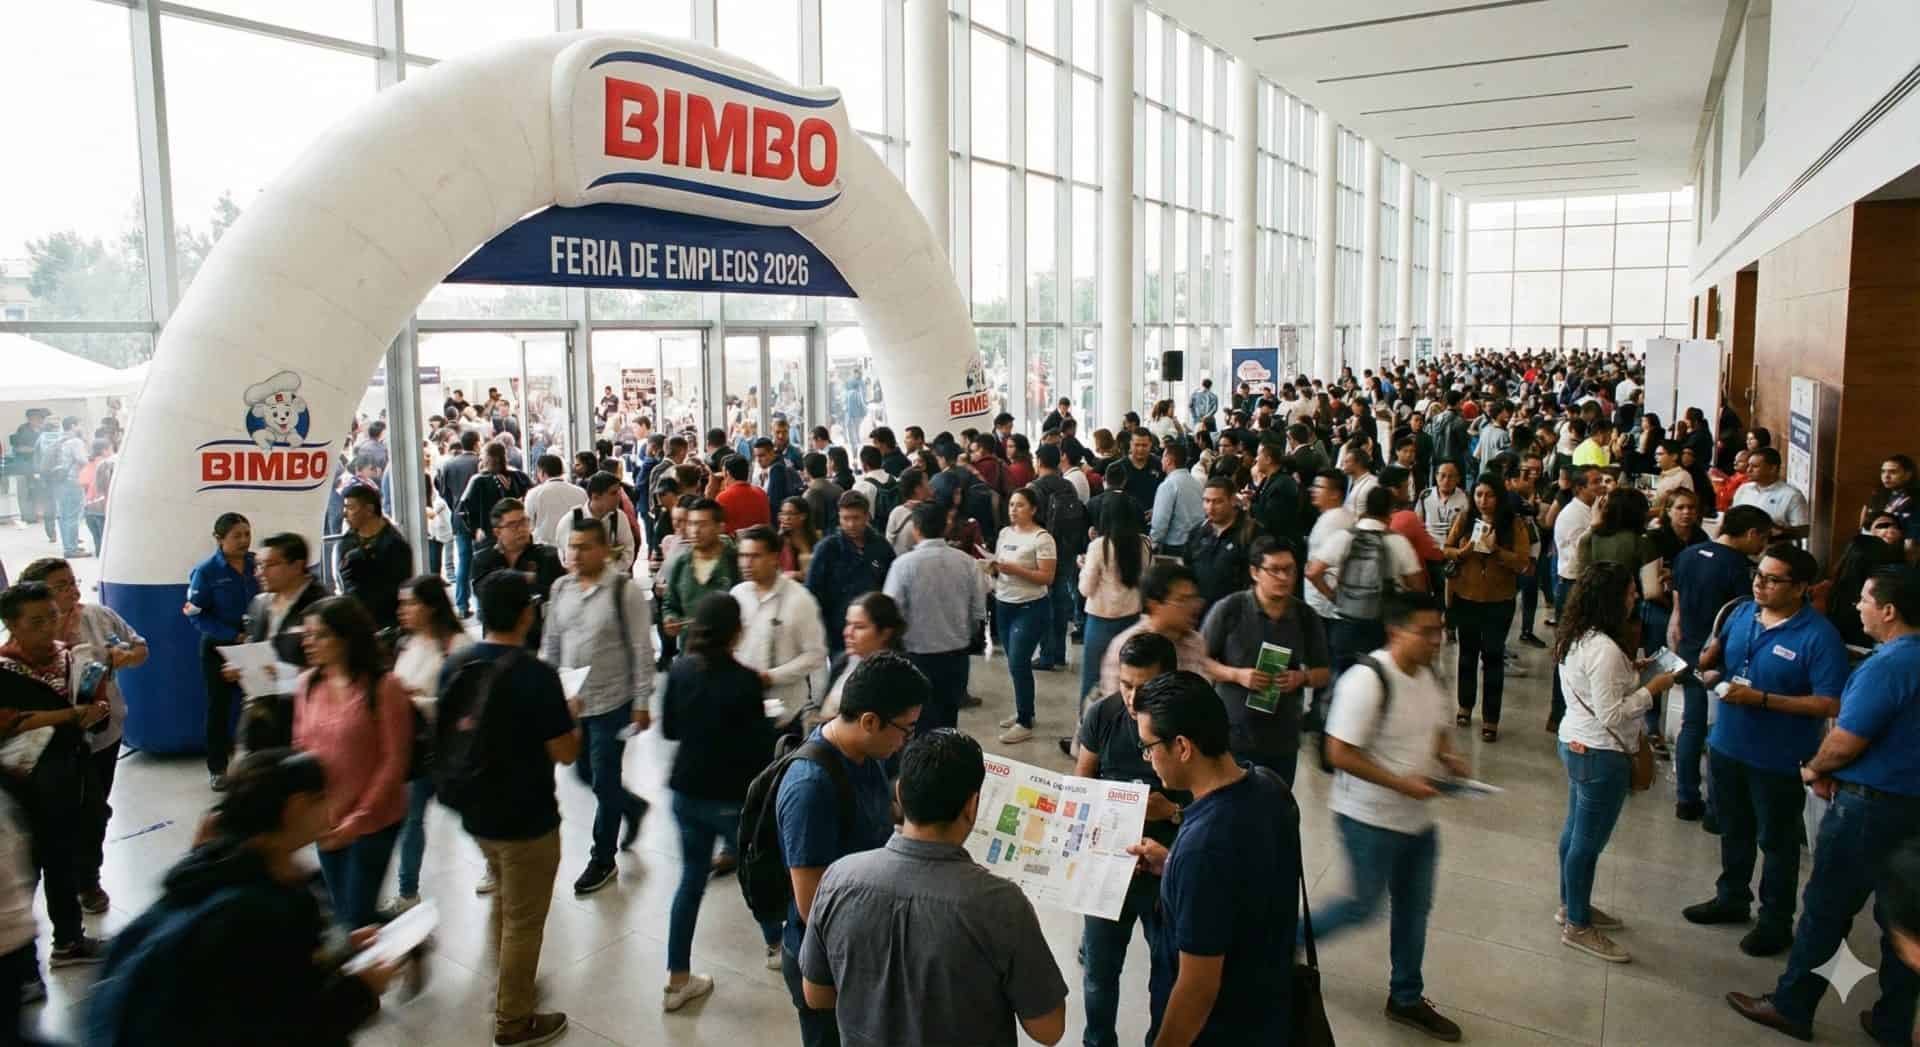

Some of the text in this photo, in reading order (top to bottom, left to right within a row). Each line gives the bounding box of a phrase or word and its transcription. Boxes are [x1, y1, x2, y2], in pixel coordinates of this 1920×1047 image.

[604, 76, 838, 187] BIMBO
[551, 235, 809, 286] FERIA DE EMPLEOS 2026
[950, 393, 989, 416] BIMB
[202, 451, 328, 481] BIMBO
